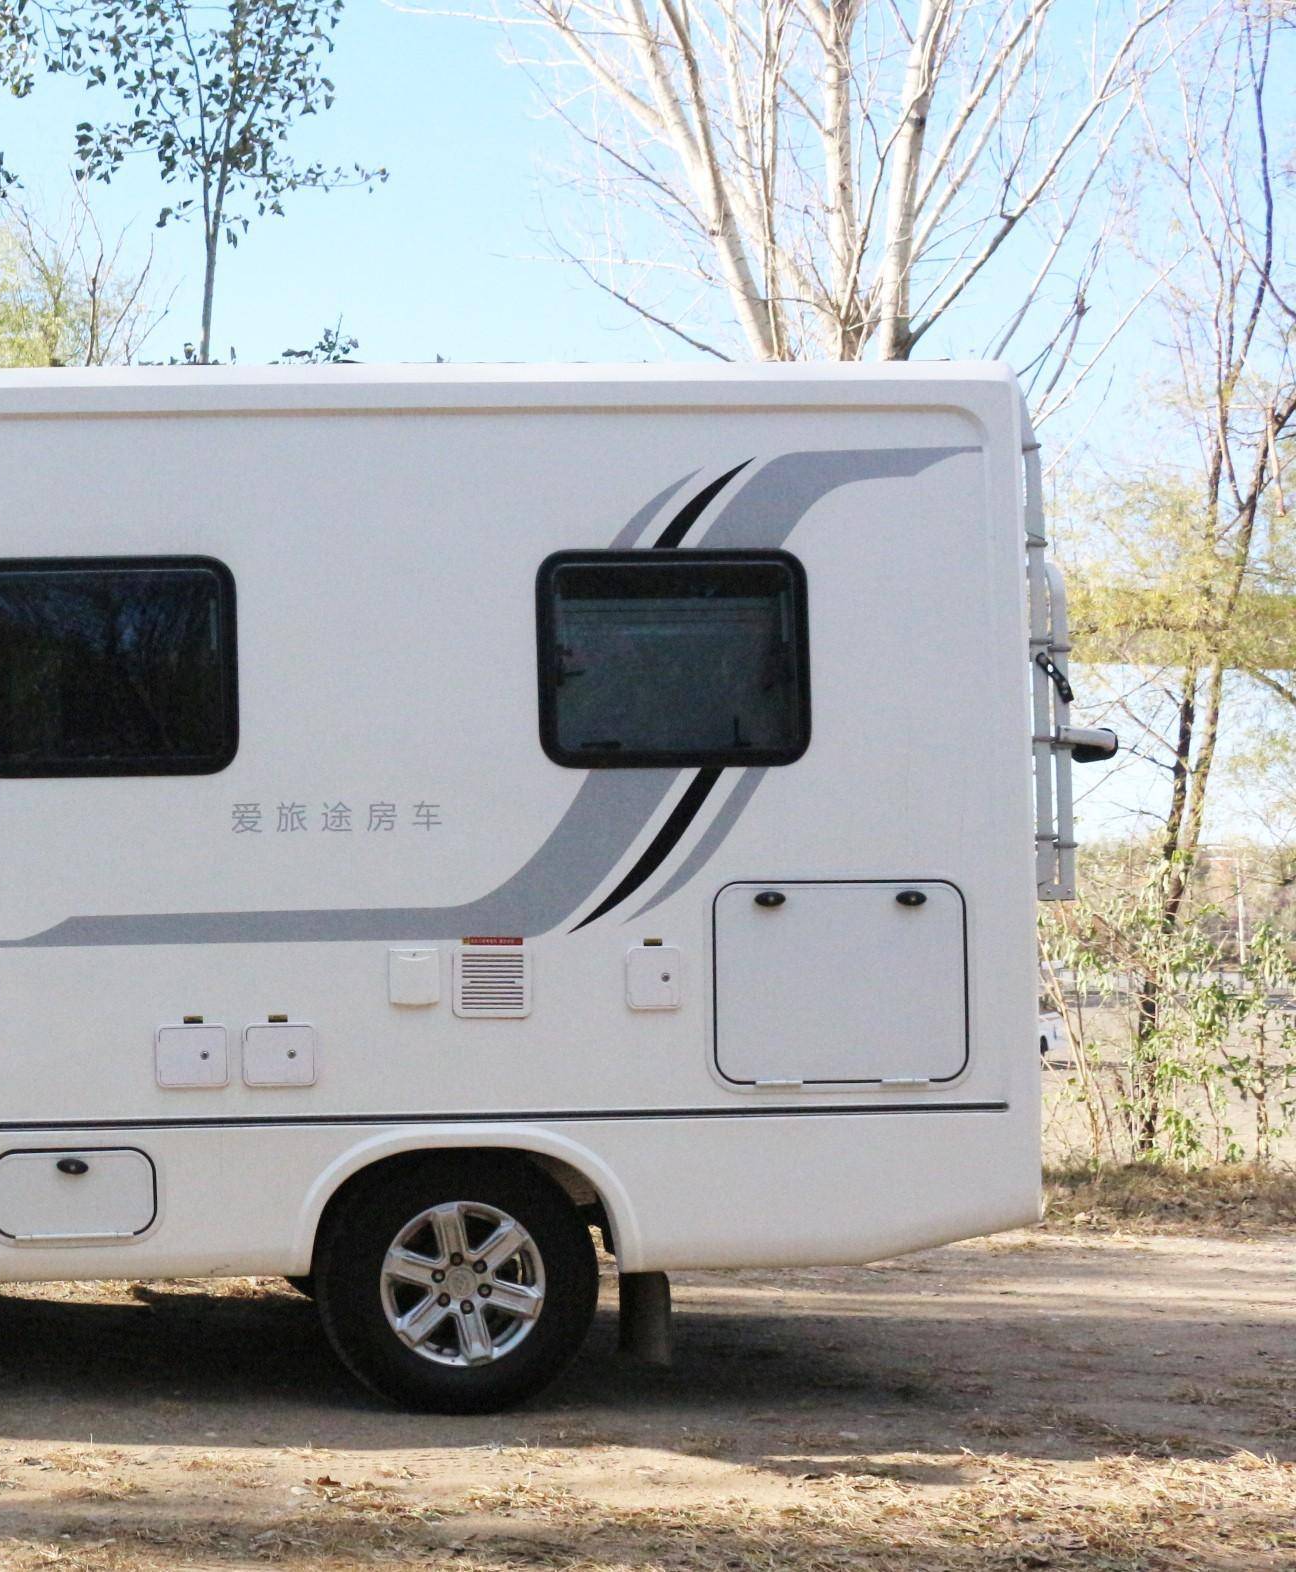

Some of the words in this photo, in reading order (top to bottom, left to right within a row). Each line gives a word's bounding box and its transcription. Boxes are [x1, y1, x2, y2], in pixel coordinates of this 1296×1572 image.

[231, 801, 442, 834] 爱旅途房车
